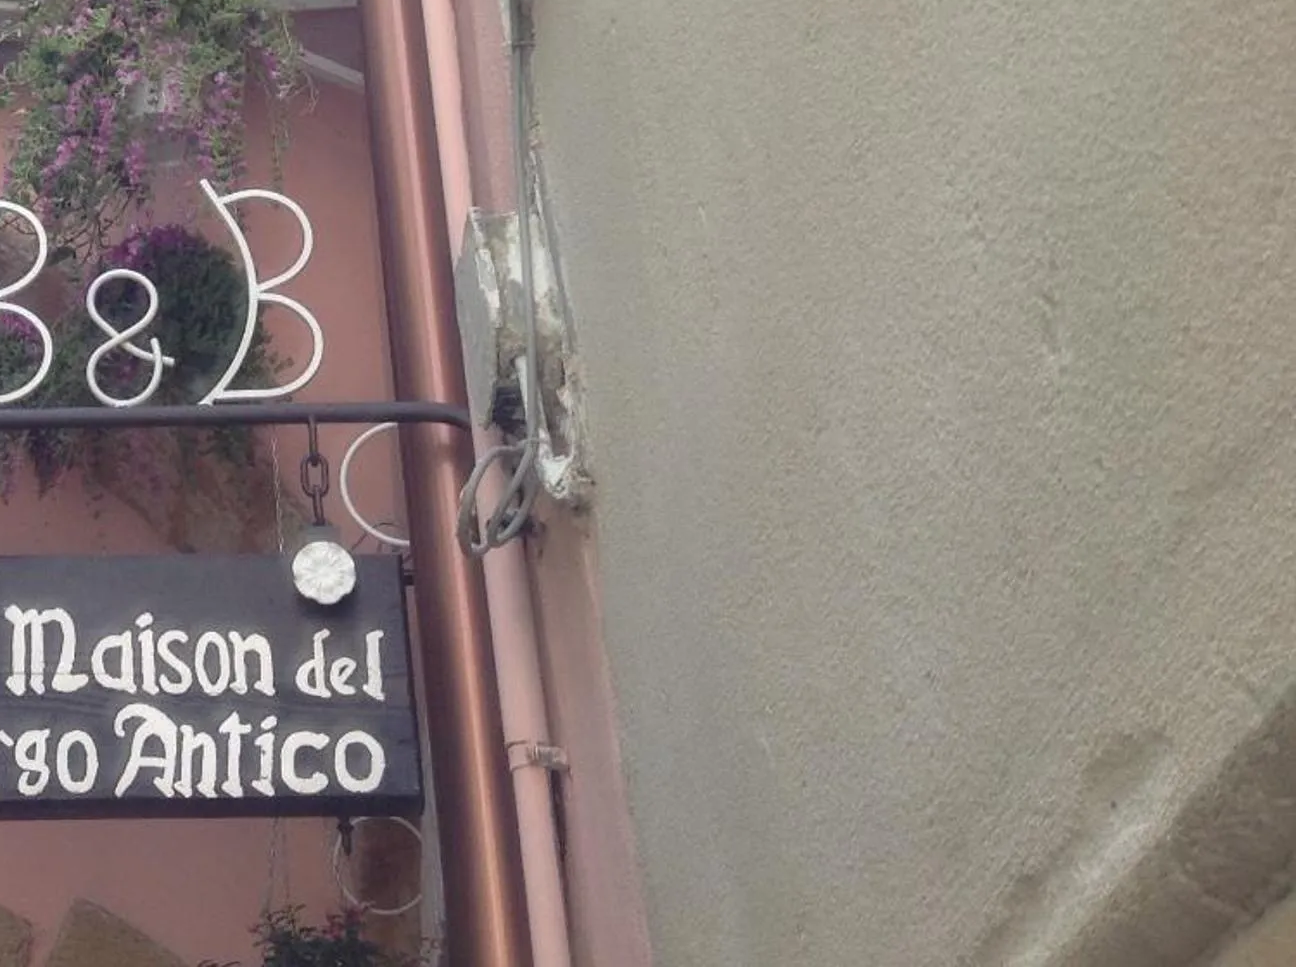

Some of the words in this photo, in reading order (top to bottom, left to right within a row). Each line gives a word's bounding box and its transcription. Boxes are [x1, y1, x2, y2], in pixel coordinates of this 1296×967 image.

[5, 605, 276, 696] Maison
[295, 629, 384, 701] del
[114, 703, 386, 798] Antico
